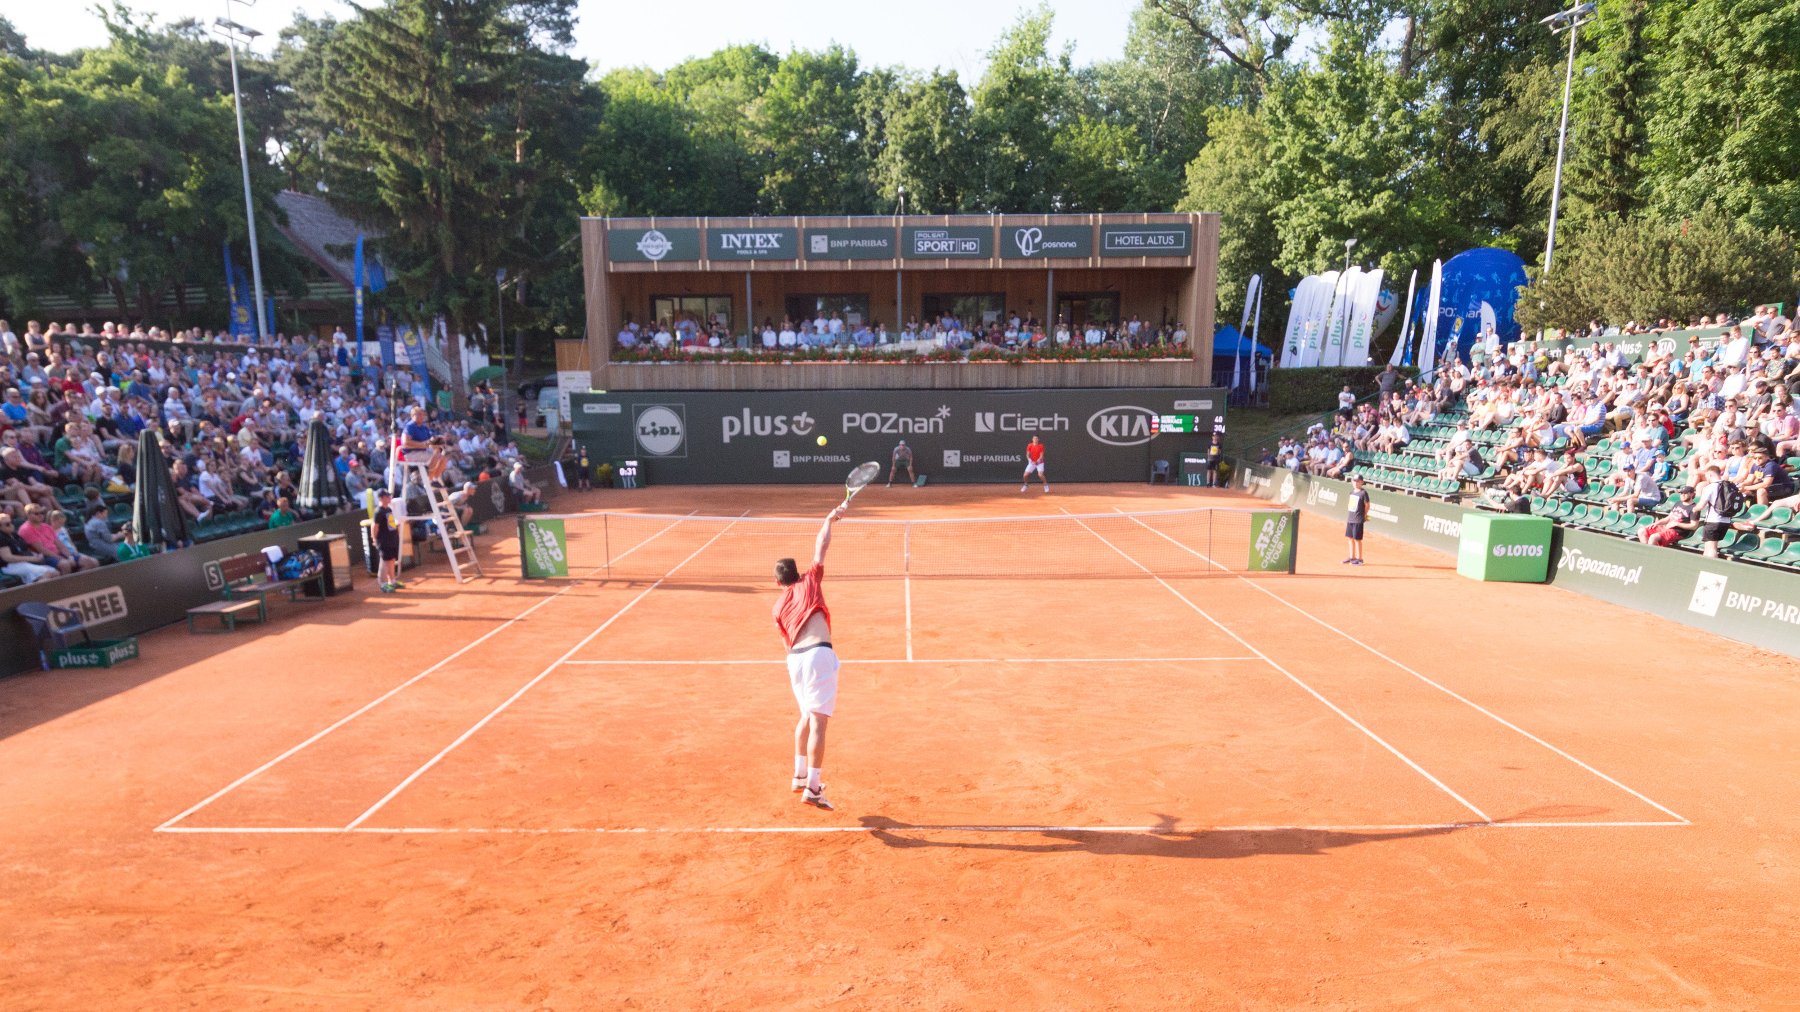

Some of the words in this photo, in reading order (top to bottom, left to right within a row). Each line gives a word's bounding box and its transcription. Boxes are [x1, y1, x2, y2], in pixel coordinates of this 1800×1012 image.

[721, 233, 781, 249] INTEX
[830, 240, 849, 248] BNP
[850, 239, 888, 247] PARIBAS
[917, 240, 955, 251] SPORT
[961, 241, 977, 251] HD
[1042, 241, 1077, 249] posnania
[1115, 236, 1144, 245] HOTEL
[1146, 235, 1174, 245] ALTUS
[1331, 319, 1343, 347] plus
[1352, 322, 1365, 349] plus
[722, 407, 788, 443] plus
[842, 412, 944, 434] POZnan
[1000, 413, 1069, 431] Ciech
[1100, 415, 1150, 437] KIA
[1214, 415, 1223, 423] 40
[793, 455, 811, 463] BNP
[813, 455, 851, 463] PARIBAS
[963, 455, 982, 463] BNP
[983, 454, 1021, 462] PARIBAS
[619, 467, 637, 477] 0:31
[1187, 473, 1201, 486] YES
[1261, 515, 1288, 569] CHALLENGER
[1507, 544, 1544, 557] LOTOS
[1270, 541, 1285, 563] TOUR
[1576, 556, 1643, 585] epoznan.pl
[1725, 591, 1762, 613] BNP
[58, 652, 88, 669] plus
[109, 646, 128, 664] plus
